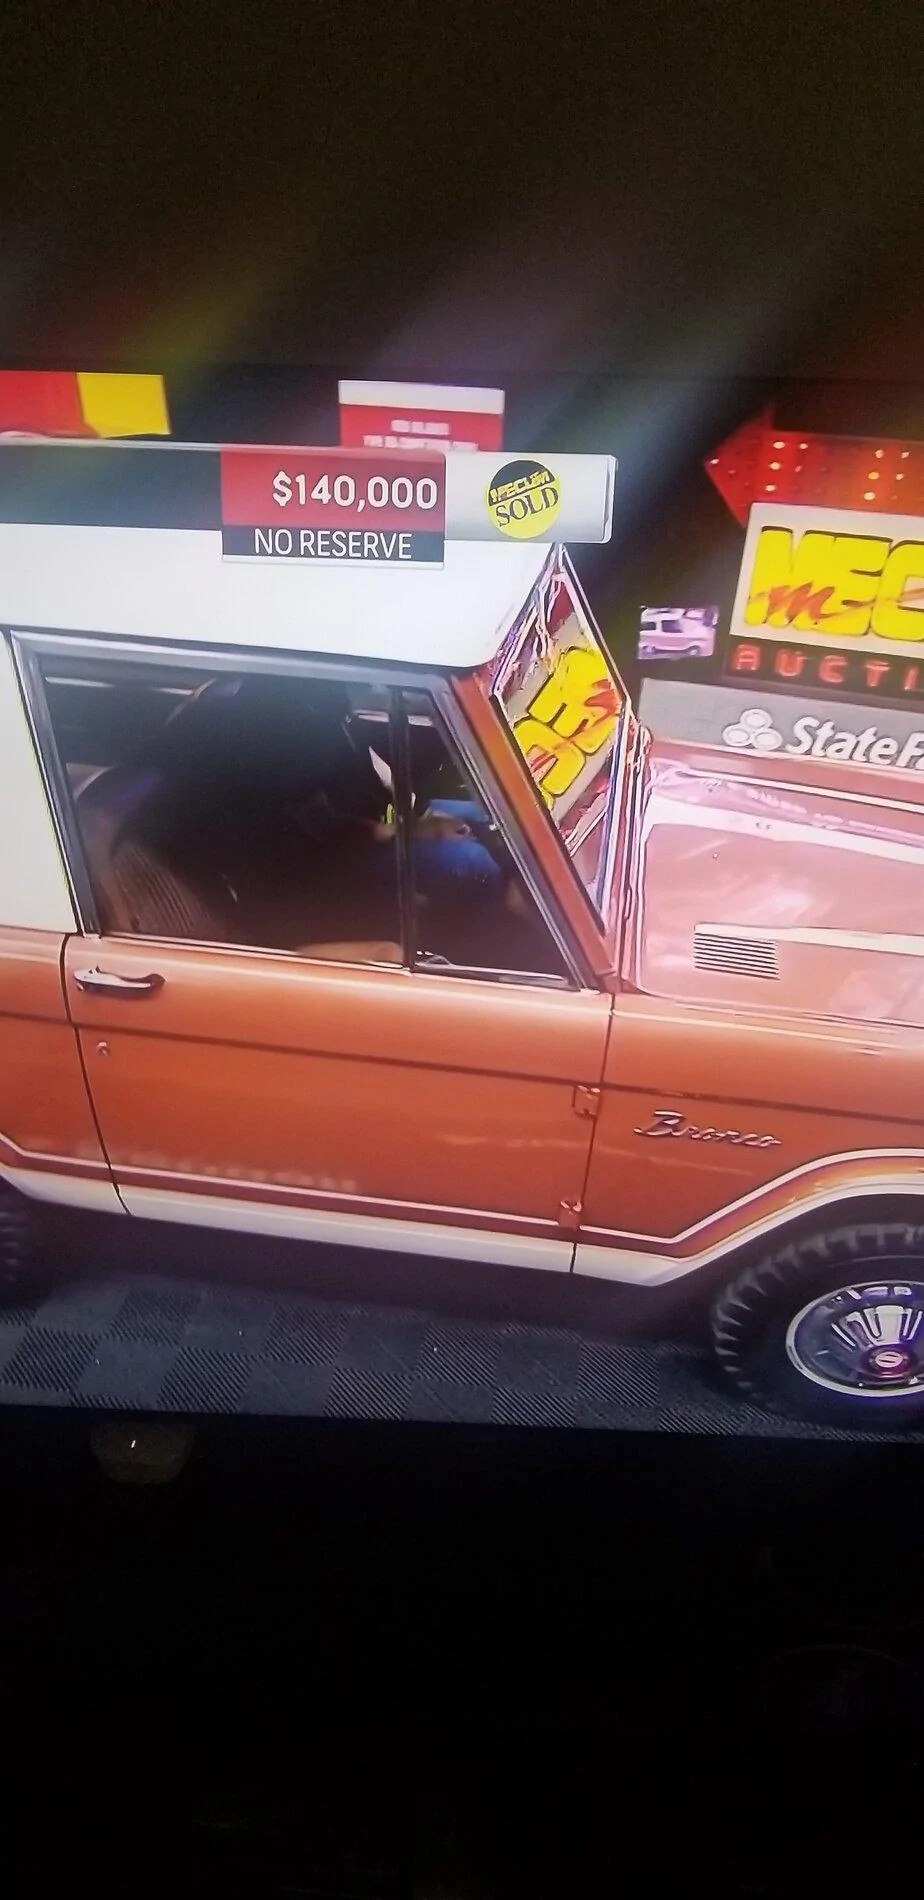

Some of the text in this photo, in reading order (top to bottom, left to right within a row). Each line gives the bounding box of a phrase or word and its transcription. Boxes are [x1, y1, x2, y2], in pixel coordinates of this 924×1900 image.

[272, 470, 438, 513] $140,000
[495, 486, 559, 528] SOLD
[253, 528, 413, 560] NO RESERVE
[633, 1109, 782, 1148] Bronco
